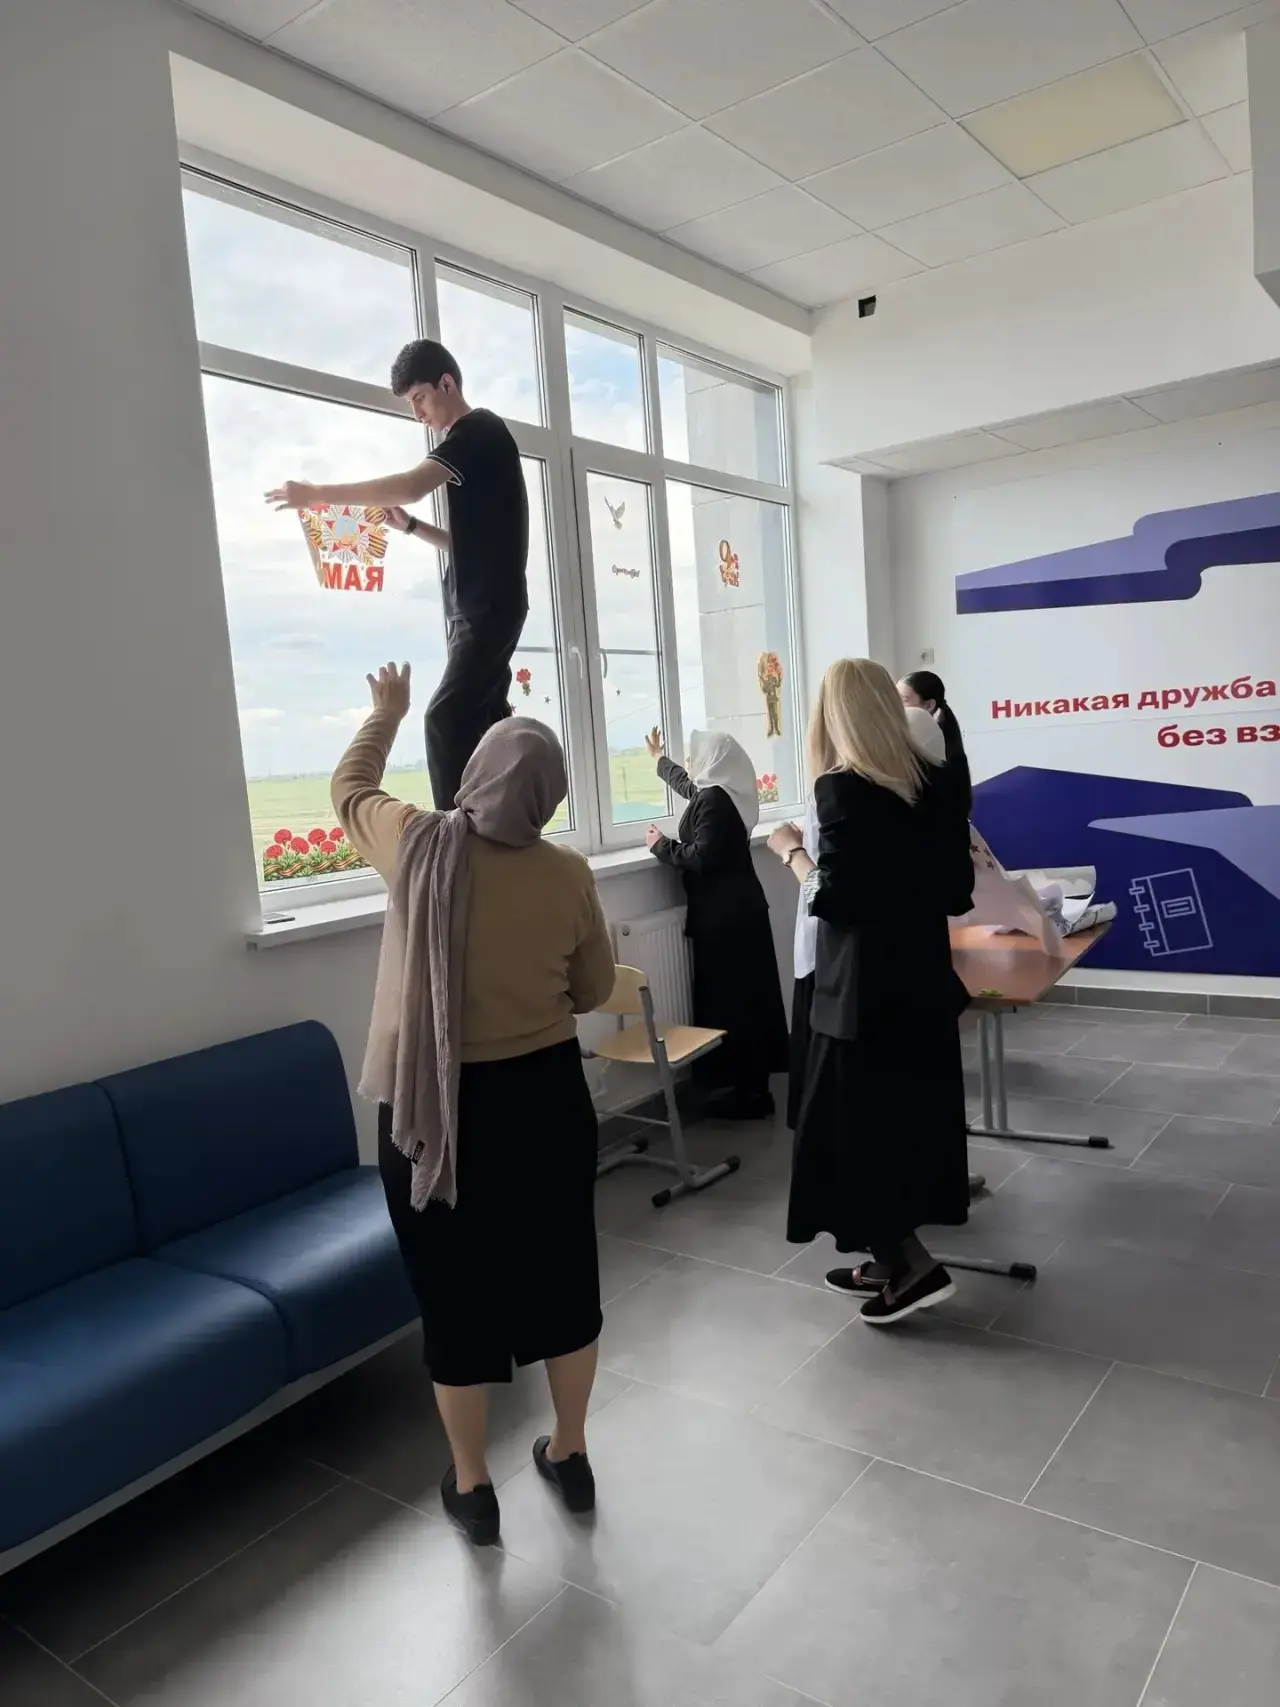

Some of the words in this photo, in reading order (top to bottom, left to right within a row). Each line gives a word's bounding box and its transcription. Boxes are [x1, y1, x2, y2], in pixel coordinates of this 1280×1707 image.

[322, 562, 384, 592] МАЯ
[991, 693, 1130, 719] Никакая
[1137, 675, 1277, 710] дружба
[1157, 724, 1228, 748] без
[1236, 724, 1280, 743] вз
